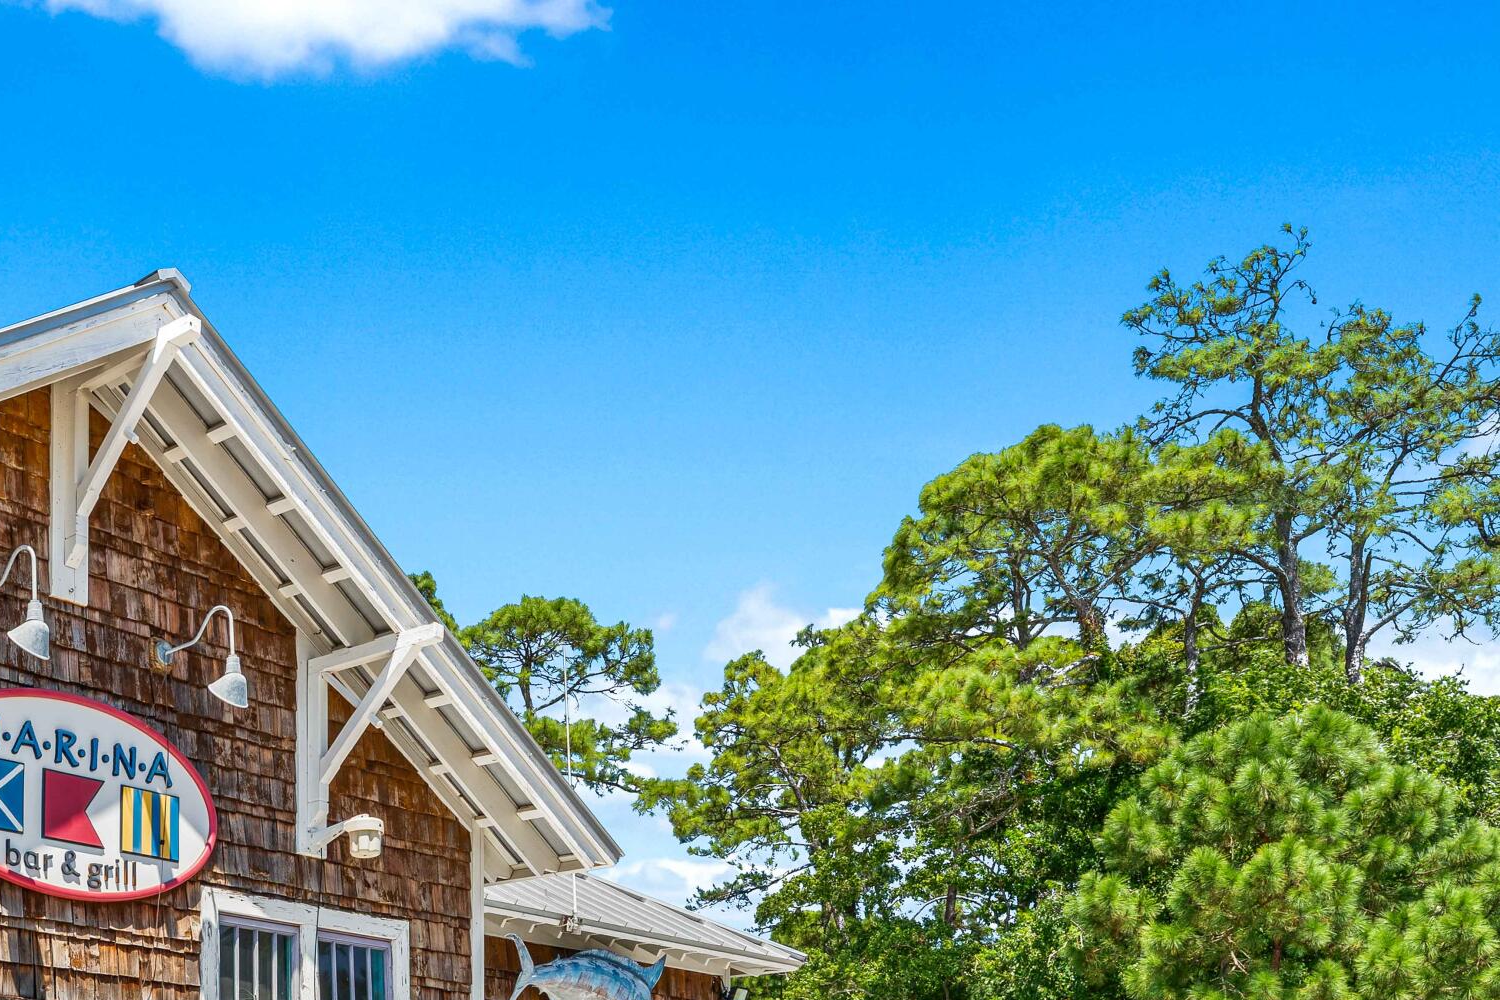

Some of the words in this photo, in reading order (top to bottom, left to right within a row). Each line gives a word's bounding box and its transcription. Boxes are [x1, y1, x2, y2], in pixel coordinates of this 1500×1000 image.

[5, 838, 53, 875] bar
[61, 850, 80, 877] &
[87, 858, 137, 890] grill
